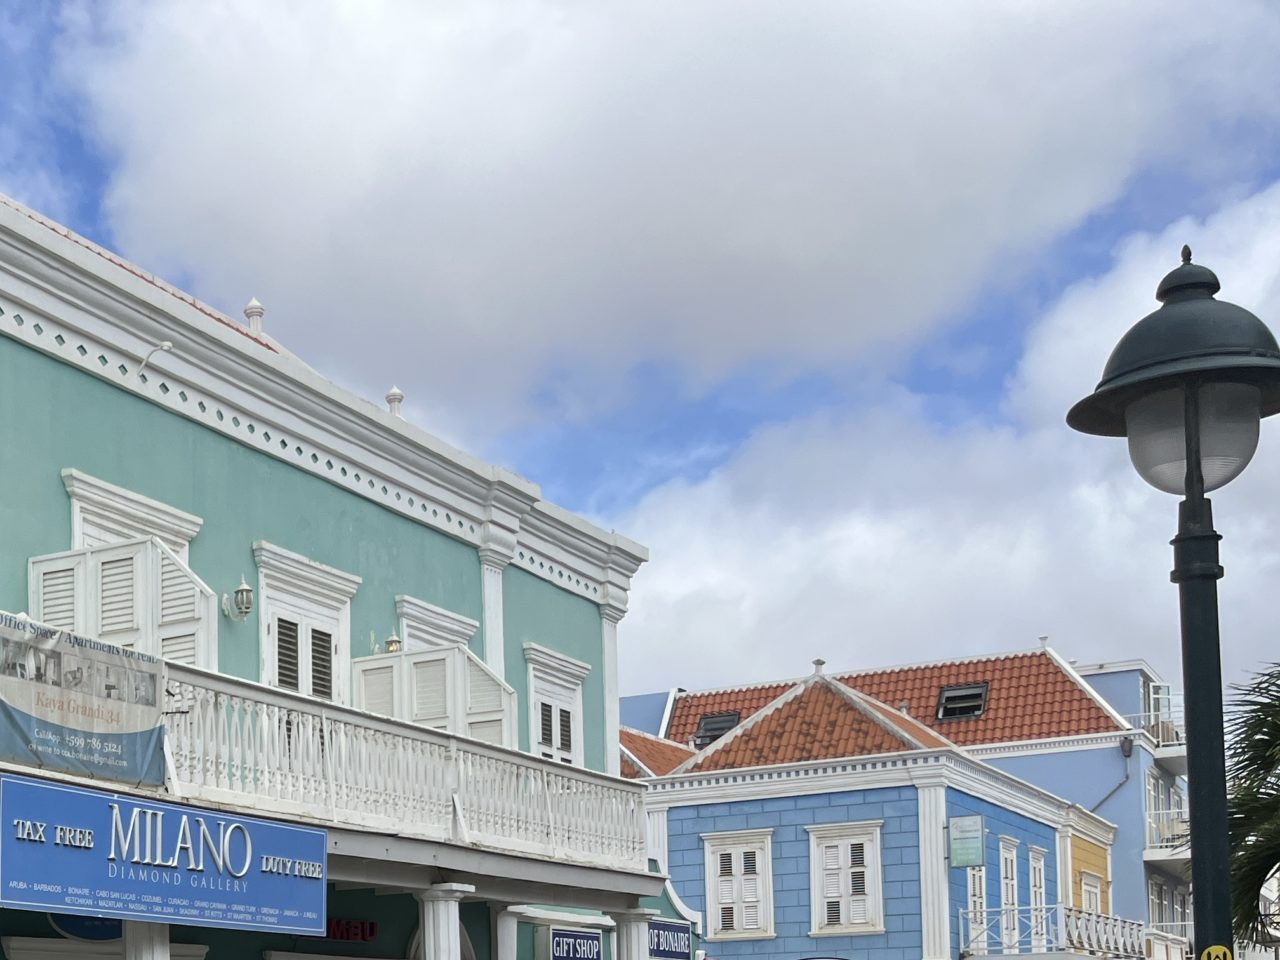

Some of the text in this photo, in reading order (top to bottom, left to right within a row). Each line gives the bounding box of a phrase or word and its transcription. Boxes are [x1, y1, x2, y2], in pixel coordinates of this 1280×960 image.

[29, 622, 57, 640] Space
[35, 691, 65, 713] Kaya
[67, 698, 105, 720] Grandi
[13, 819, 95, 849] TAX FREE
[108, 803, 253, 878] MILANO
[108, 863, 248, 893] DIAMOND GALLERY
[260, 855, 323, 879] DUTY FREE
[9, 881, 27, 889] ARUBA
[33, 883, 62, 893] BARBADOS
[67, 887, 90, 896] BONAIRE
[553, 936, 599, 959] GIFT SHOP
[649, 929, 689, 953] OF BONAIRE
